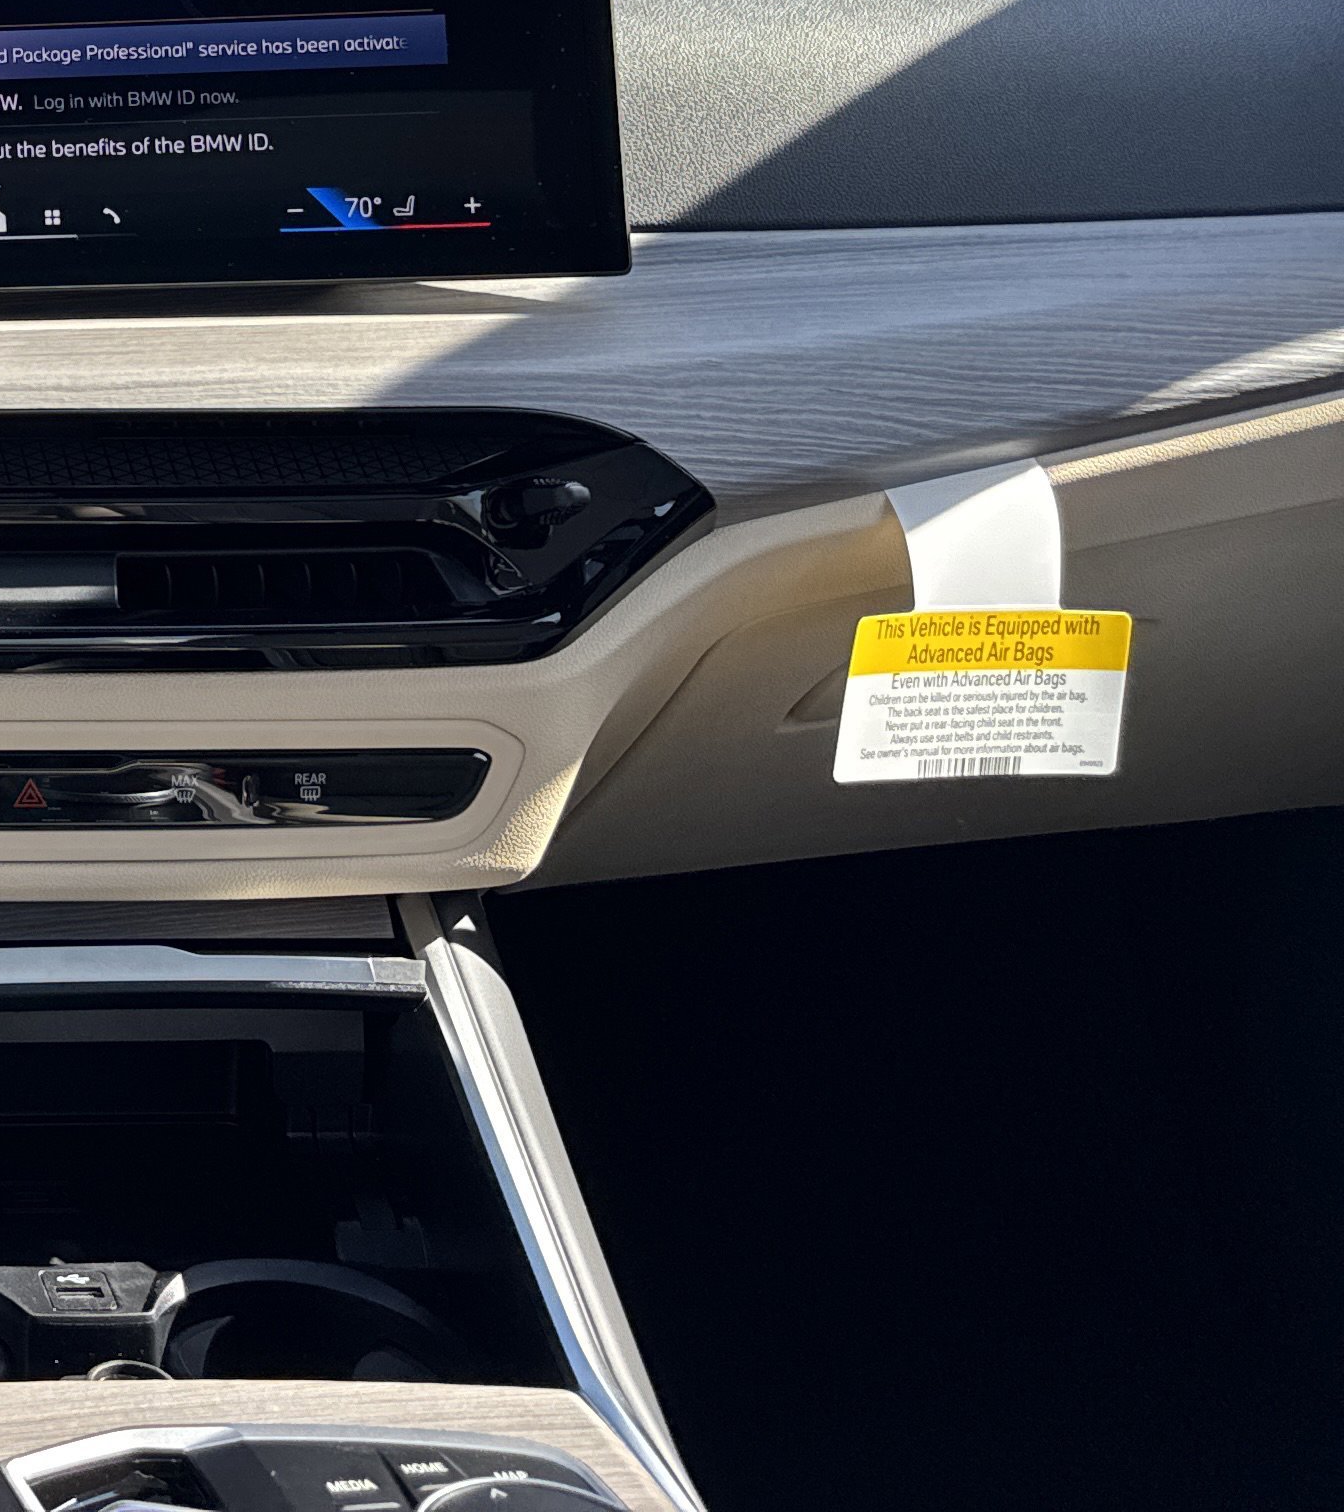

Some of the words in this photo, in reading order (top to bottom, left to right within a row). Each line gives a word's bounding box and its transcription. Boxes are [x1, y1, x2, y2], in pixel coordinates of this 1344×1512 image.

[12, 46, 82, 66] Package
[86, 41, 194, 61] Professional"
[198, 39, 257, 58] service
[262, 38, 293, 55] has
[296, 36, 340, 54] been
[343, 34, 409, 52] activate
[34, 94, 65, 113] Log
[69, 92, 84, 110] in
[88, 90, 123, 108] with
[127, 89, 173, 107] BMW
[177, 89, 195, 106] ID
[200, 90, 240, 105] now.
[16, 140, 47, 159] the
[51, 137, 127, 158] benefits
[131, 136, 151, 155] of
[154, 135, 186, 155] the
[191, 134, 243, 154] BMW
[248, 132, 275, 152] ID.
[876, 619, 905, 640] This
[909, 616, 964, 638] Vehicle
[968, 615, 981, 636] is
[985, 614, 1062, 640] Equipped
[1064, 615, 1101, 636] with
[906, 641, 985, 665] Advanced
[986, 641, 1011, 663] Air
[1013, 641, 1054, 667] Bags
[891, 673, 920, 690] Even
[923, 671, 949, 688] with
[950, 670, 1012, 688] Advanced
[1013, 669, 1032, 686] Air
[1034, 669, 1067, 689] Bags
[869, 694, 901, 707] Children
[902, 694, 917, 704] can
[918, 692, 929, 703] be
[930, 691, 952, 703] killed
[953, 693, 962, 702] or
[963, 690, 998, 704] seriously
[1000, 689, 1028, 702] injured
[1029, 689, 1040, 702] by
[1041, 689, 1055, 701] the
[1056, 689, 1067, 701] air
[1069, 688, 1088, 703] bag.
[888, 706, 902, 718] The
[903, 706, 923, 717] back
[924, 705, 941, 716] seat
[943, 706, 950, 716] is
[951, 704, 964, 715] the
[966, 704, 990, 715] safest
[992, 704, 1014, 717] place
[1015, 702, 1027, 714] for
[1028, 702, 1064, 714] children.
[885, 719, 909, 732] Never
[909, 719, 924, 732] put
[924, 721, 930, 730] a
[931, 718, 975, 731] rear-facing
[976, 717, 996, 729] child
[998, 717, 1015, 728] seat
[1016, 717, 1024, 727] in
[1025, 716, 1039, 727] the
[1040, 715, 1064, 728] front.
[890, 733, 918, 746] Always
[919, 734, 934, 744] use
[935, 732, 953, 743] seat
[954, 731, 974, 742] belts
[975, 730, 991, 742] and
[992, 730, 1012, 741] child
[1013, 729, 1054, 741] restraints.
[860, 748, 876, 760] See
[877, 746, 909, 759] owner's
[910, 745, 940, 757] manual
[940, 744, 952, 755] for
[953, 745, 975, 755] more
[976, 743, 1022, 755] information
[1023, 742, 1048, 754] about
[1049, 742, 1060, 753] air
[1061, 741, 1085, 756] bags.
[170, 774, 199, 787] MAX
[294, 772, 326, 785] REAR
[400, 1461, 449, 1475] HOME
[493, 1469, 530, 1481] MAP
[325, 1478, 380, 1493] MEDIA
